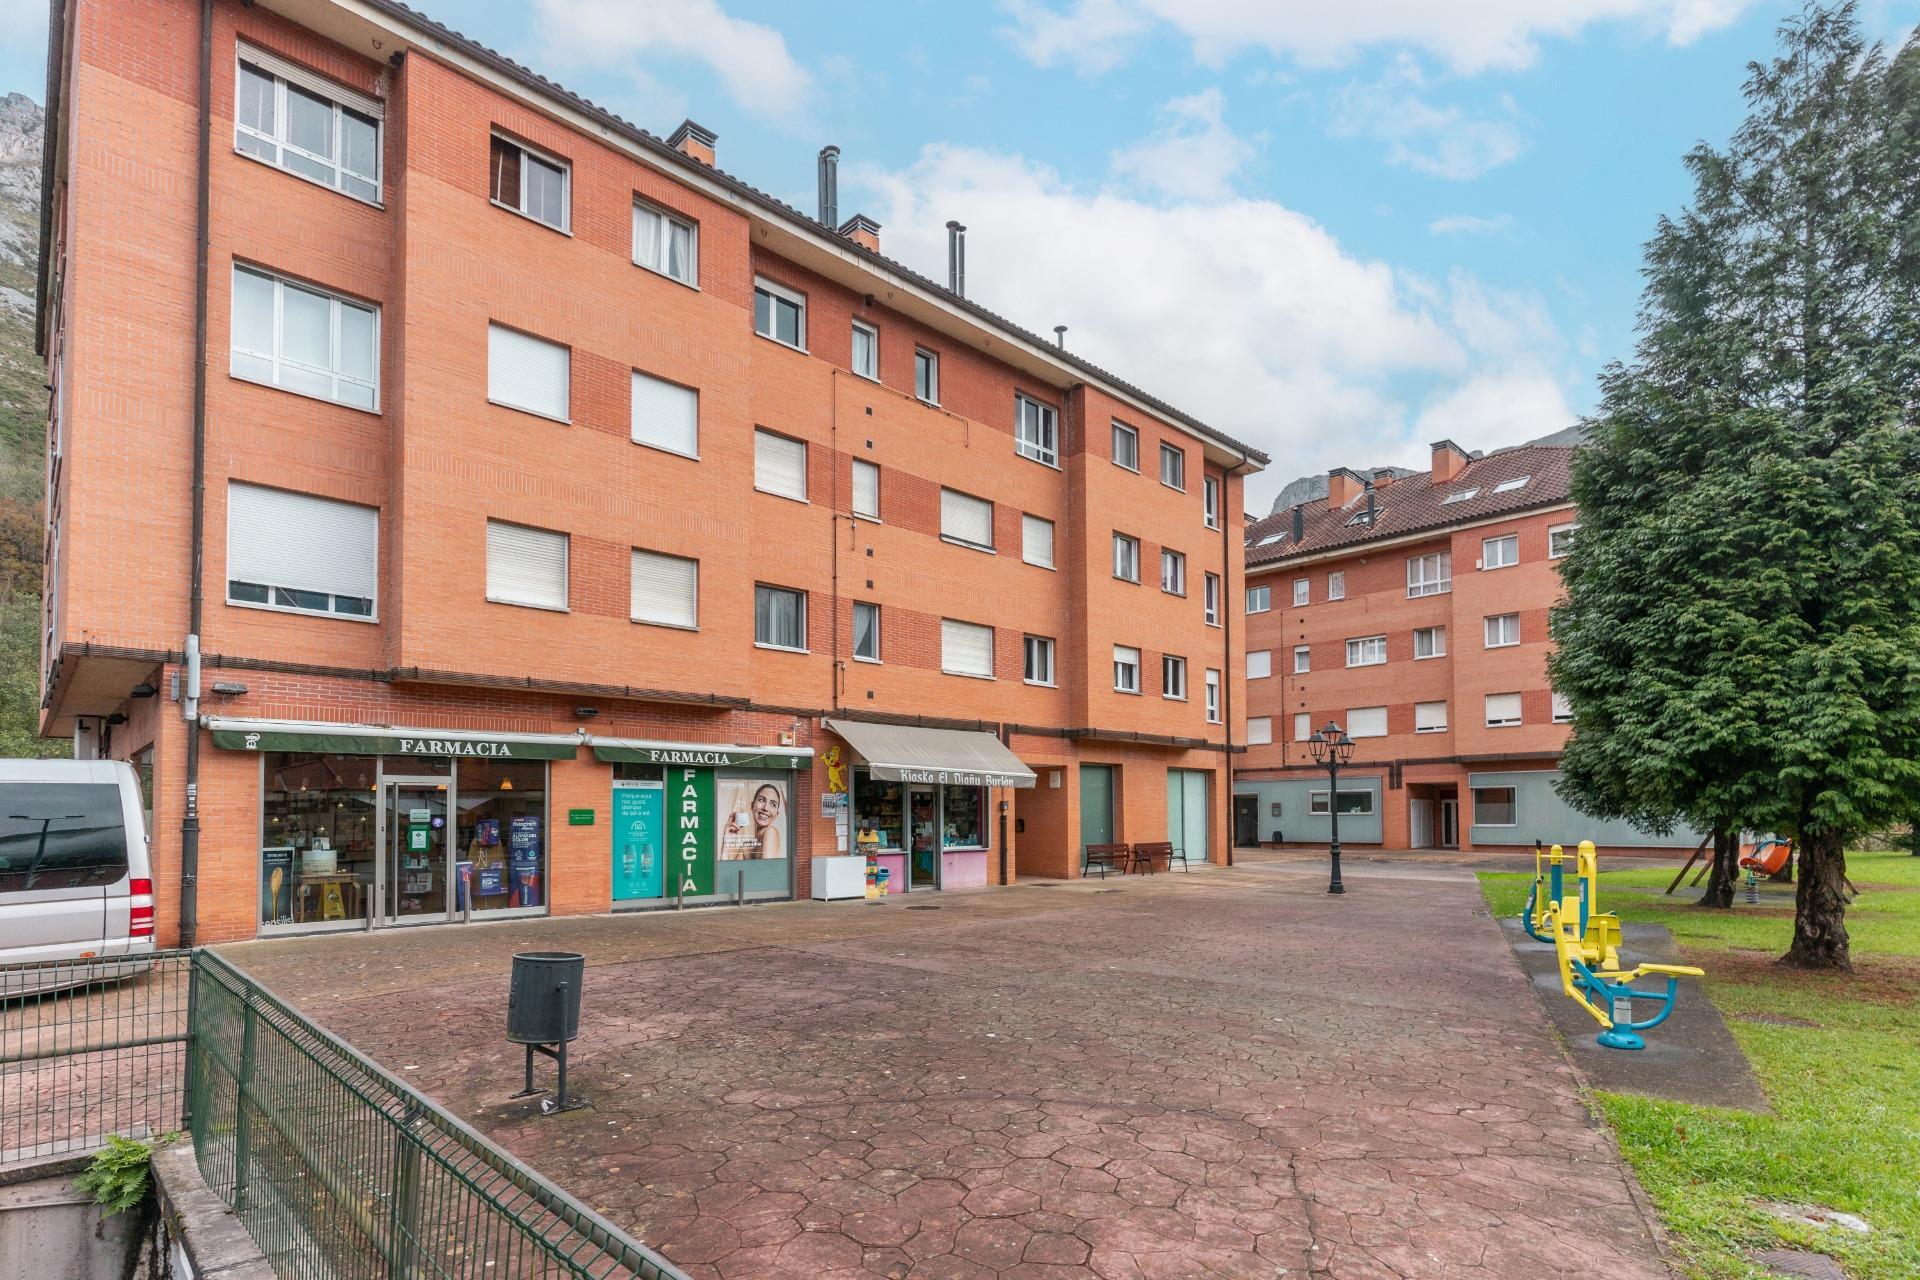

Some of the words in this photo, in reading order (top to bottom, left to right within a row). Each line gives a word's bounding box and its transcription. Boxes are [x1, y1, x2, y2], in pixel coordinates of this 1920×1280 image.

[400, 739, 512, 756] FARMACIA
[650, 750, 730, 765] FARMACIA
[680, 769, 699, 892] FARMACIA
